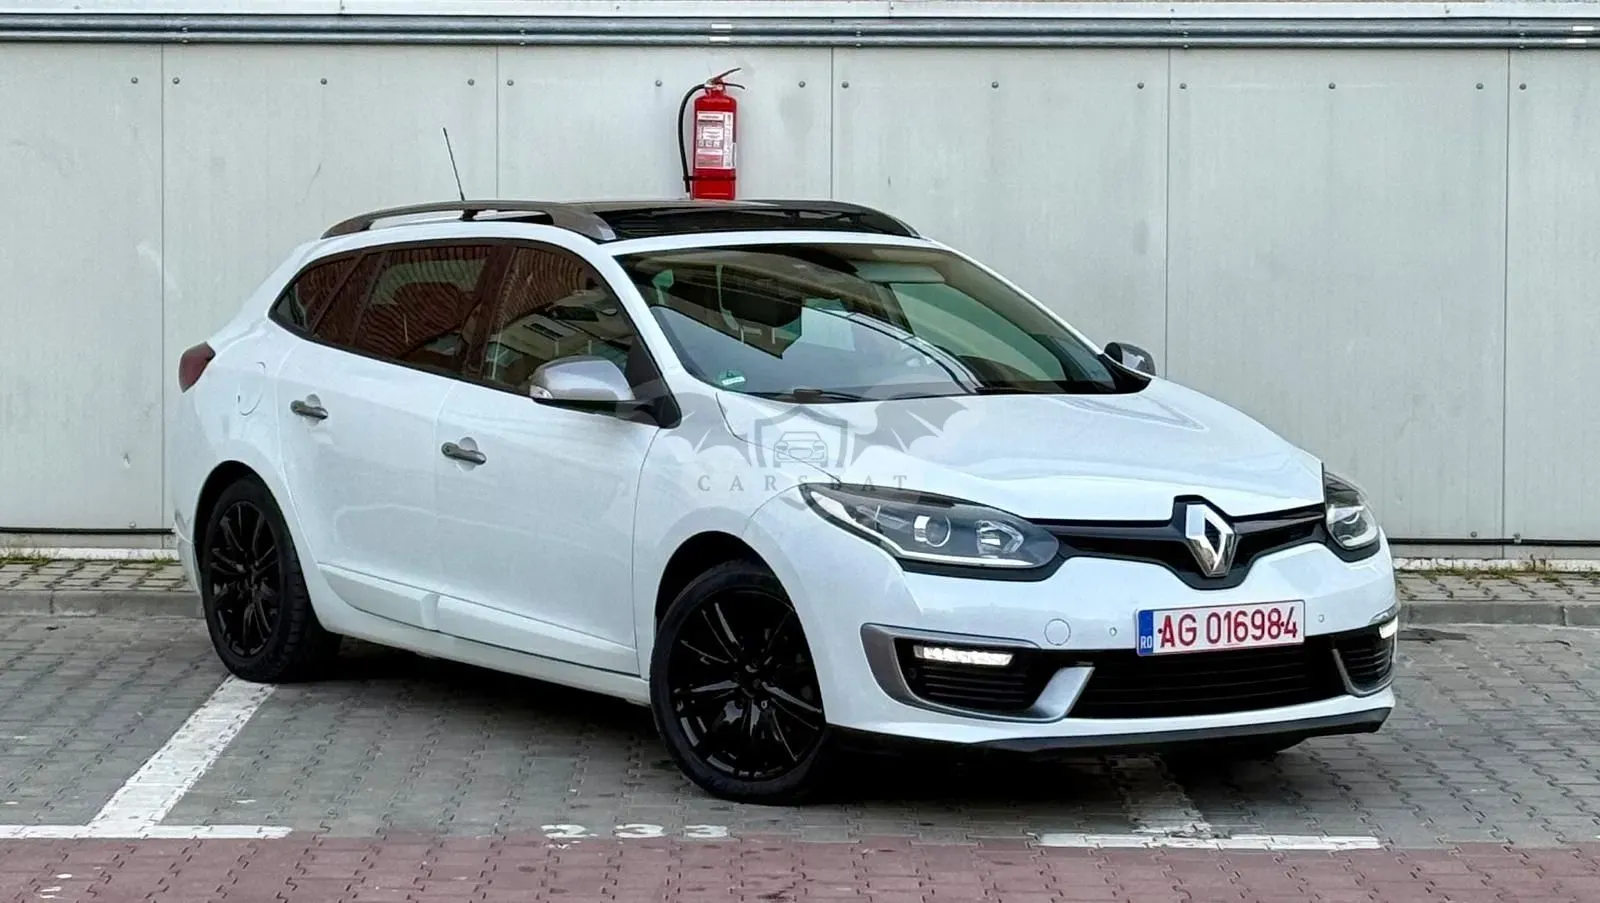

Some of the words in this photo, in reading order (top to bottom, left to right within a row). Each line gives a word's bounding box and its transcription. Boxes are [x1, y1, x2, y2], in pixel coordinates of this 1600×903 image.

[1160, 613, 1198, 648] AG
[1206, 607, 1298, 644] 016984
[1139, 635, 1153, 649] RO
